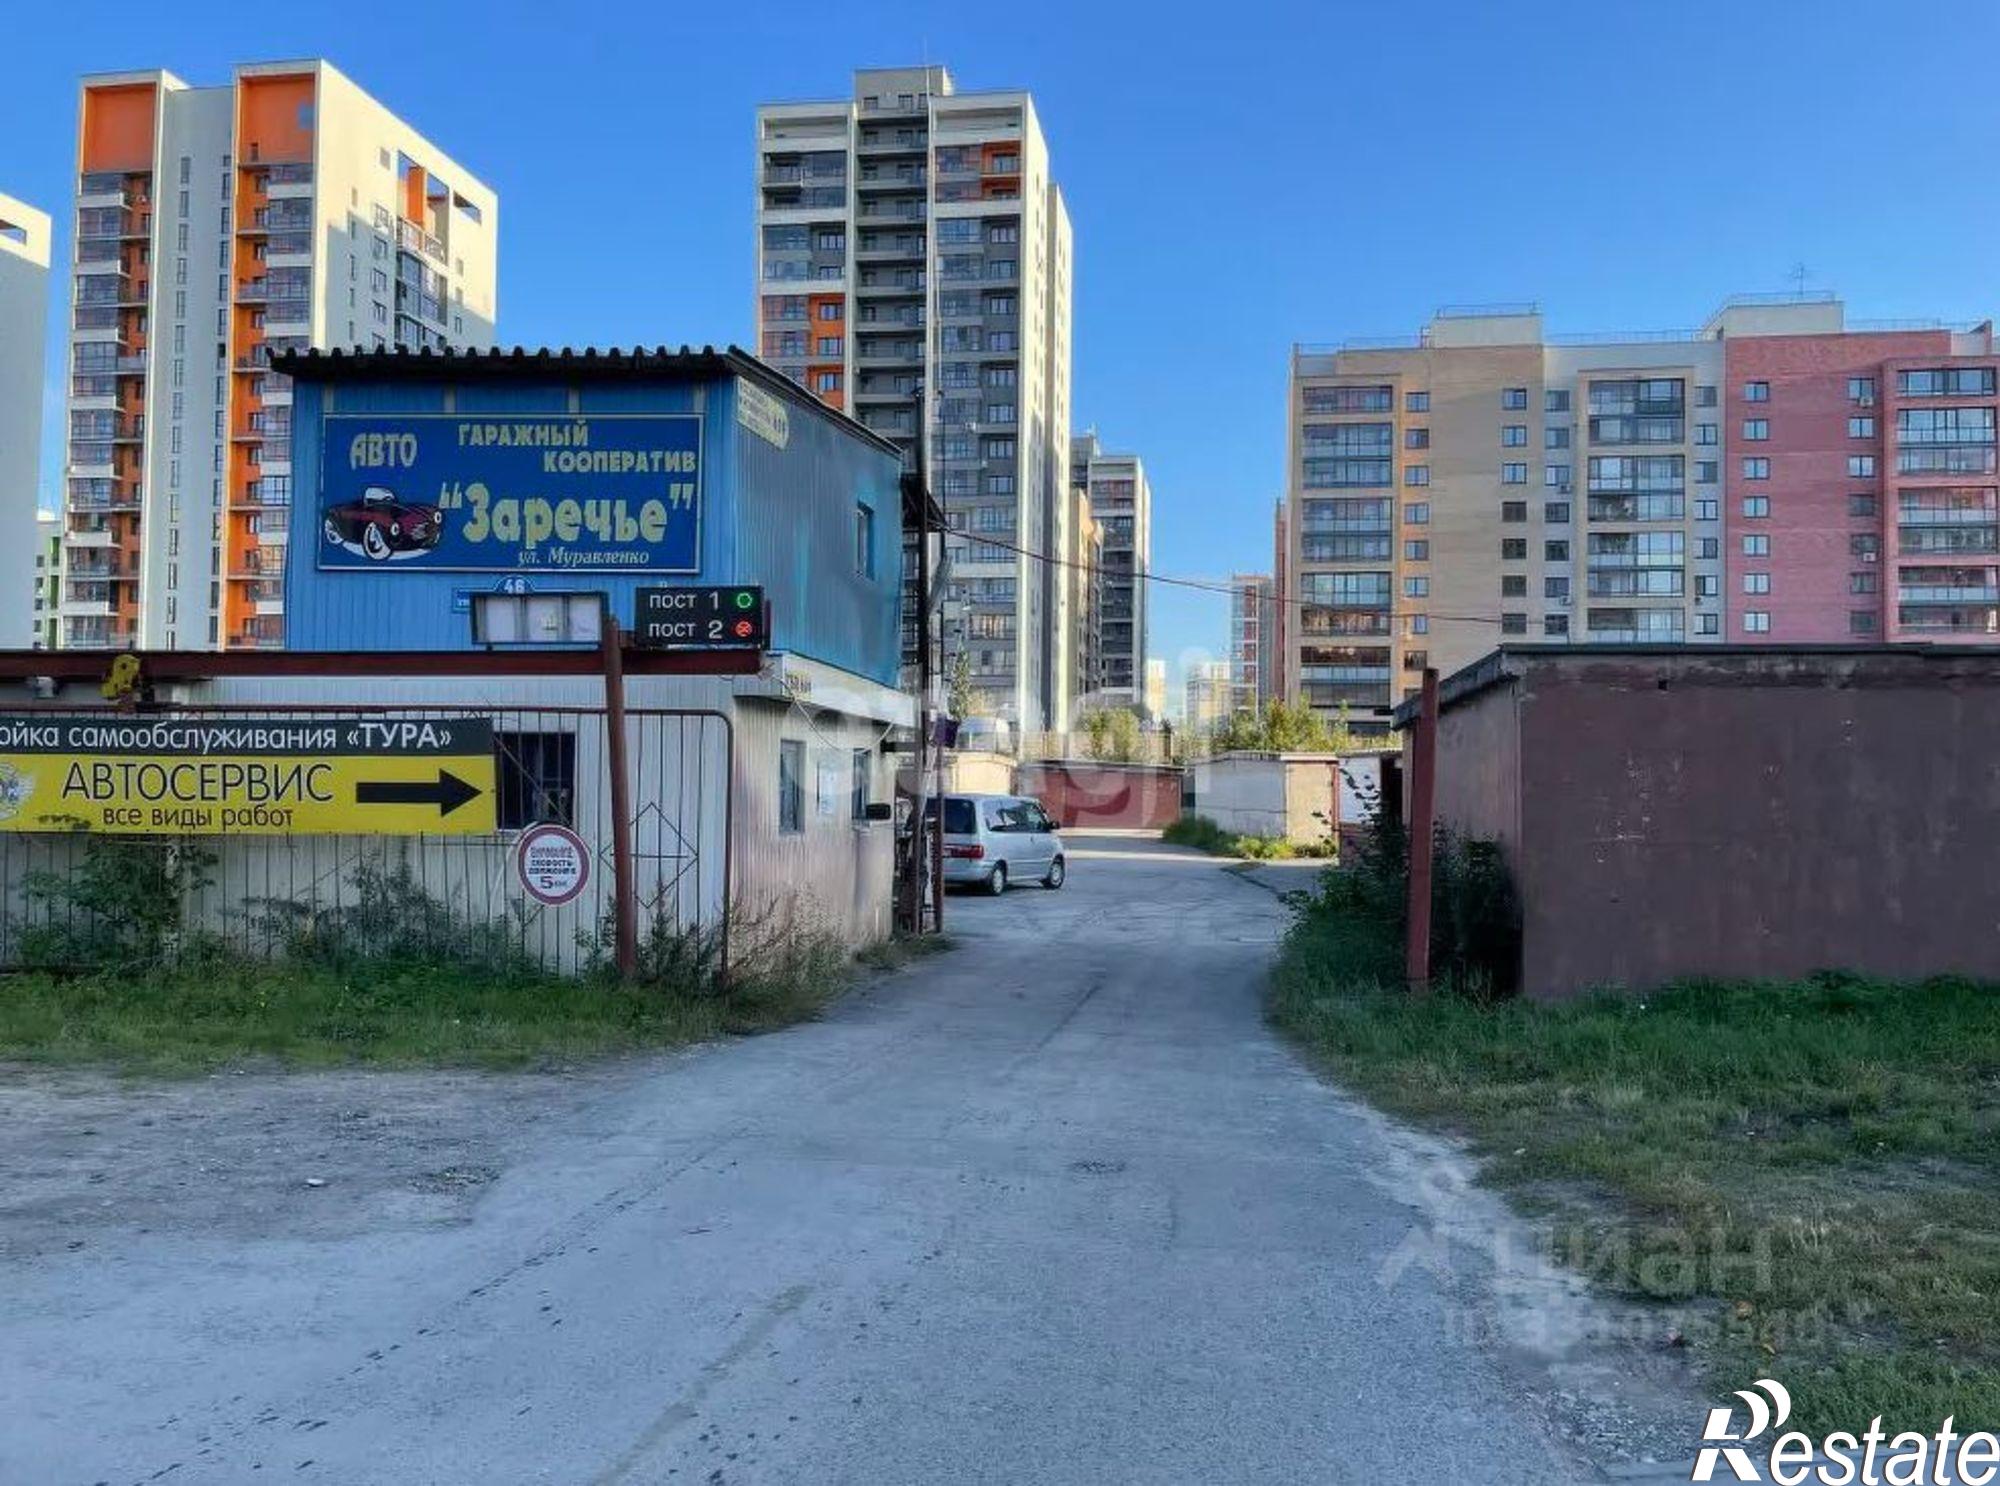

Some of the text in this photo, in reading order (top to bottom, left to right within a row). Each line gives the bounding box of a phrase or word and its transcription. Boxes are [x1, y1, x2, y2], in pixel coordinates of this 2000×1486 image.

[458, 420, 588, 446] ГАРАЖНЫЙ
[351, 432, 418, 470] АВТО
[543, 451, 696, 473] КООПЕРАТИВ
[518, 546, 649, 568] ул. Муравленко
[503, 578, 526, 595] 46
[708, 591, 719, 610] 1
[708, 620, 723, 639] 2
[68, 721, 337, 755] самообслуживания
[347, 722, 453, 749] «ТУРА»
[62, 762, 333, 801] АВТОСЕРВИС
[103, 803, 294, 831] все виды работ
[540, 876, 554, 889] 5
